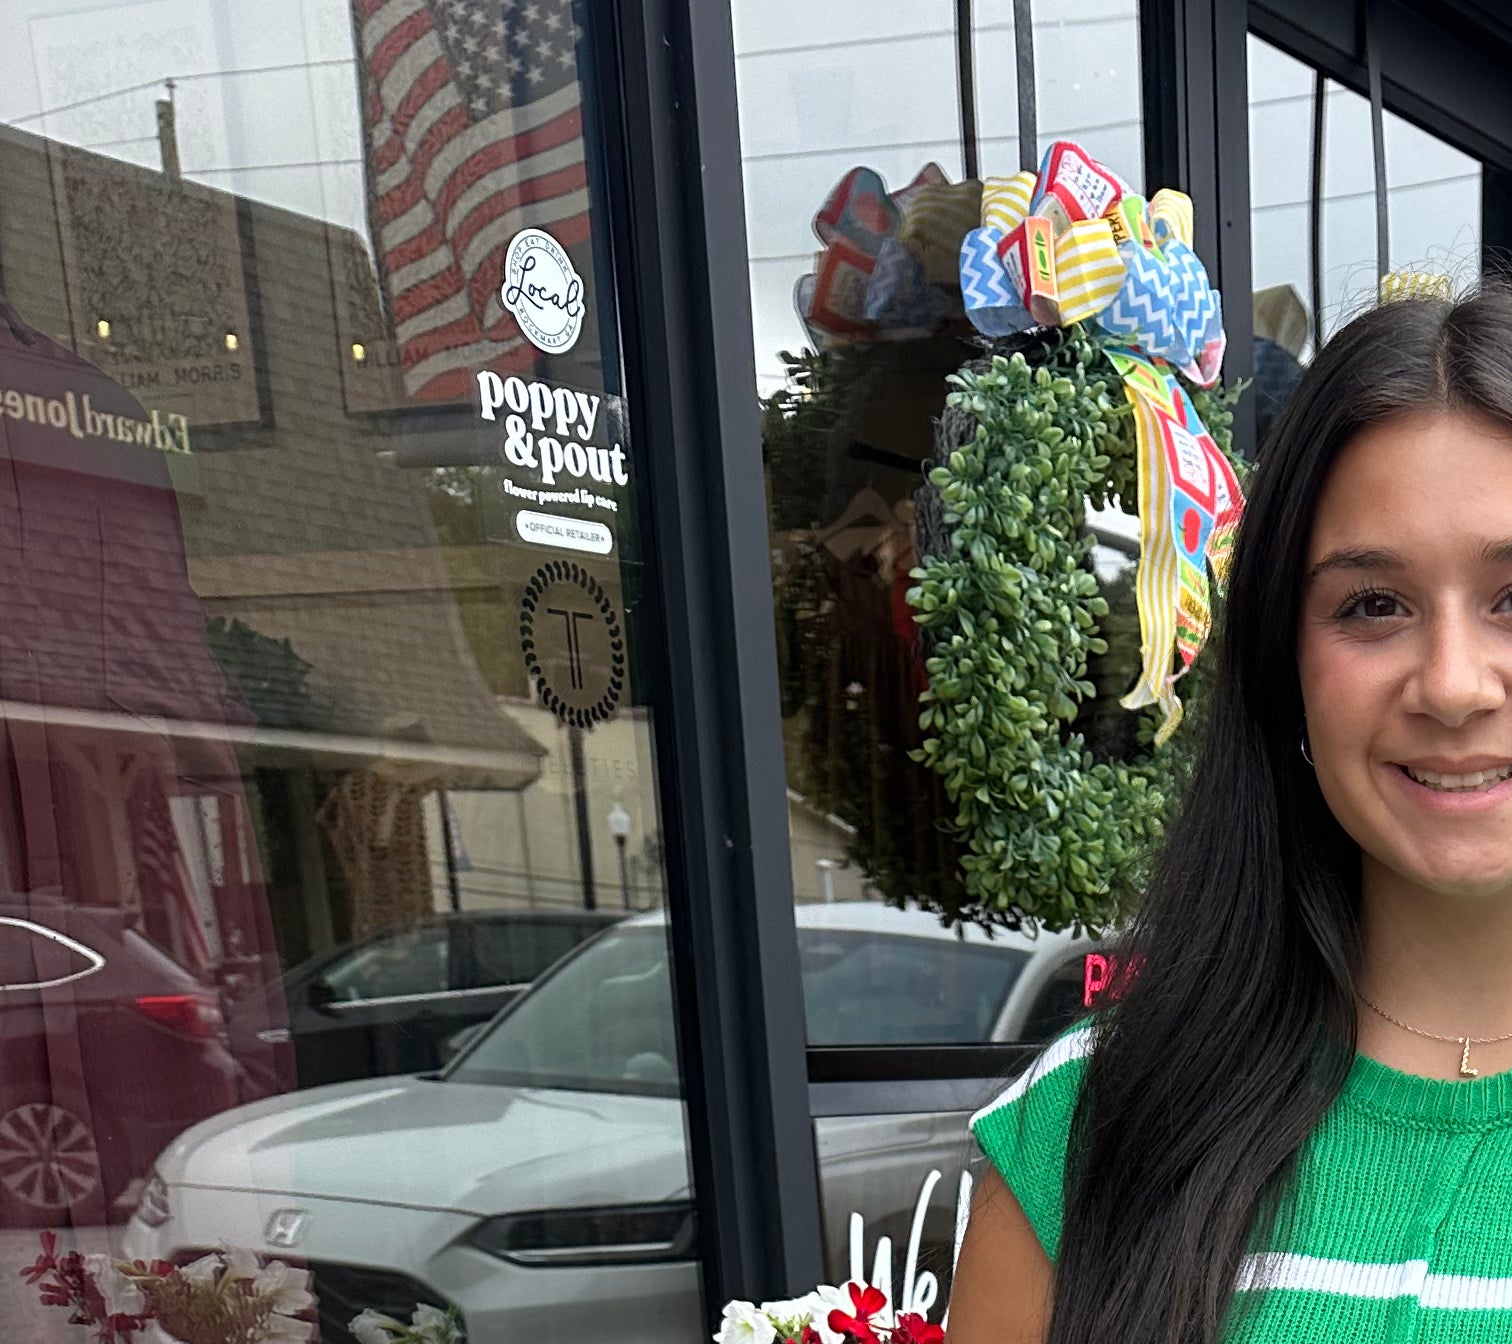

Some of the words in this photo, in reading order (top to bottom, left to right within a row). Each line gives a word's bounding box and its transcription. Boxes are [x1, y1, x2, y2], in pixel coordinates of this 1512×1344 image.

[525, 237, 541, 248] EAT
[506, 255, 581, 318] Local
[476, 370, 600, 441] poppy
[503, 478, 538, 501] flower
[538, 488, 580, 506] powered
[529, 522, 564, 538] OFFICIAL
[566, 528, 601, 543] RETAILER
